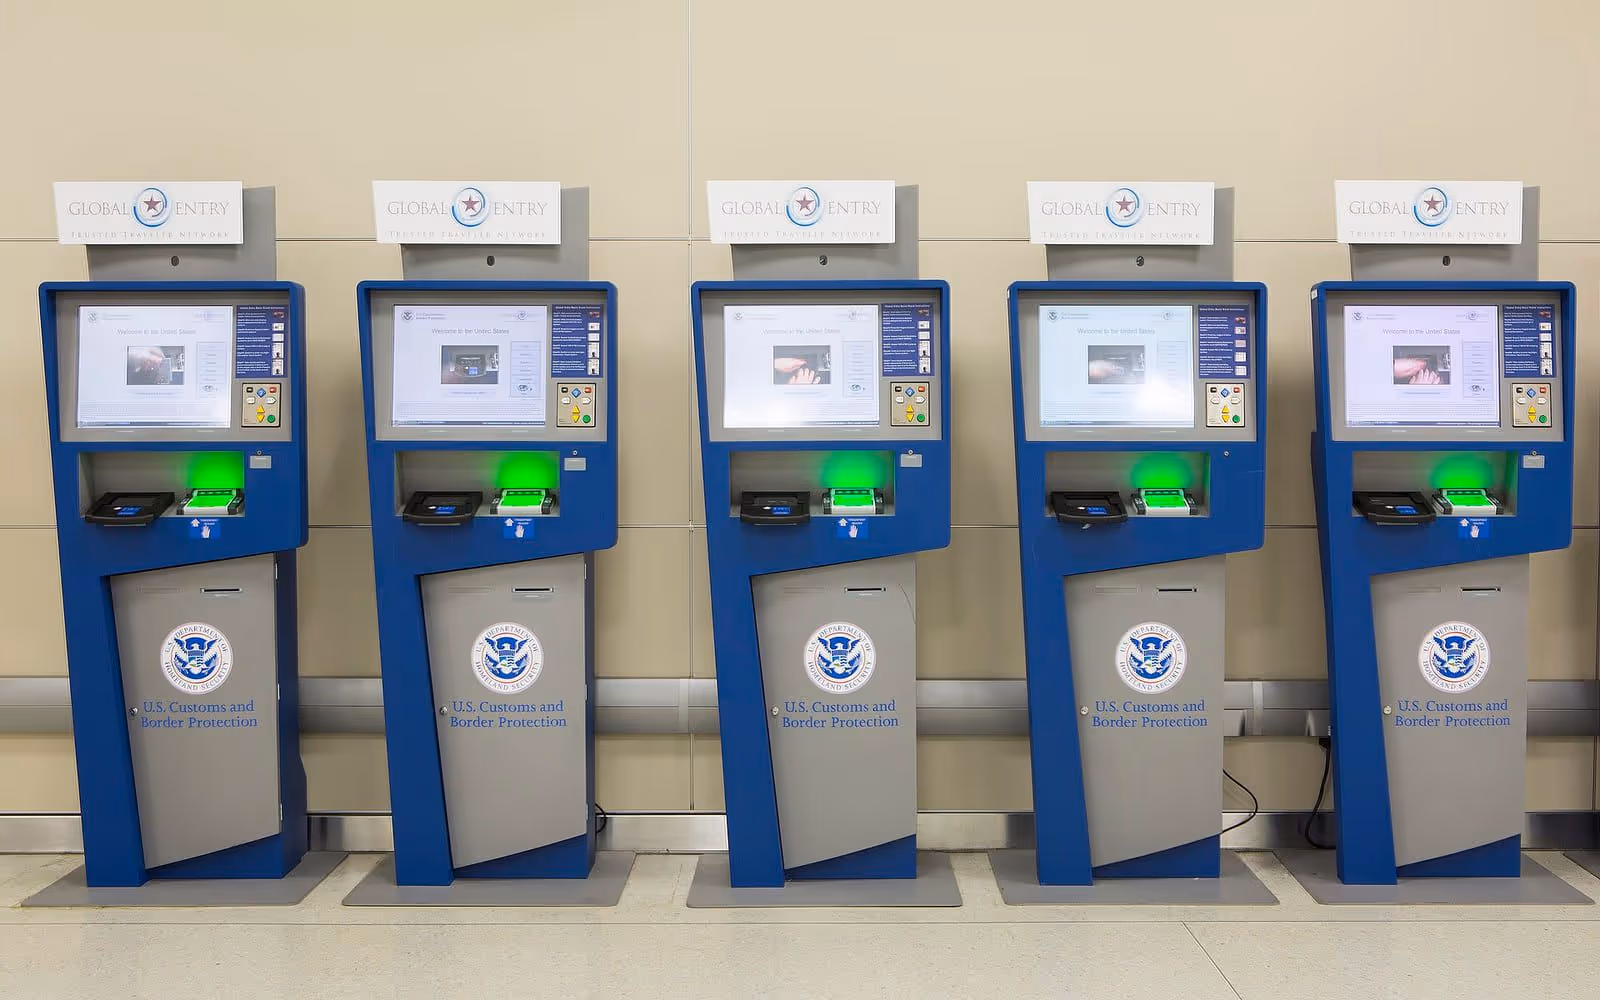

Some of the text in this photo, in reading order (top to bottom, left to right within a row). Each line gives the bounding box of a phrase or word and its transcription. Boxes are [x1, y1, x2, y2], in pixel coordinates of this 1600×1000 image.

[68, 201, 230, 215] GLOBAL ENTRY
[387, 201, 548, 215] GLOBAL ENTRY
[721, 201, 881, 215] GLOBAL ENTRY
[1041, 202, 1201, 216] GLOBAL ENTRY
[1349, 201, 1510, 215] GLOBAL ENTRY
[175, 625, 223, 643] DEPARTMENT
[486, 625, 534, 643] DEPARTMENT
[819, 625, 867, 643] DEPARTMENT
[1131, 625, 1178, 643] DEPARTMENT
[1434, 625, 1482, 642] DEPARTMENT
[165, 661, 229, 691] HOMELAND SECURITY
[475, 661, 540, 691] HOMELAND SECURITY
[808, 661, 872, 691] HOMELAND SECURITY
[1120, 661, 1183, 691] HOMELAND SECURITY
[1423, 660, 1486, 690] HOMELAND SECURITY
[143, 700, 255, 713] U.S. Customs and
[452, 700, 564, 713] U.S. Customs and
[784, 700, 896, 713] U.S. Customs and
[1095, 700, 1205, 713] U.S. Customs and
[1397, 699, 1508, 712] U.S. Customs and
[140, 716, 258, 728] Border Protection
[450, 716, 567, 728] Border Protection
[782, 716, 900, 728] Border Protection
[1092, 716, 1208, 728] Border Protection
[1395, 715, 1511, 727] Border Protection
